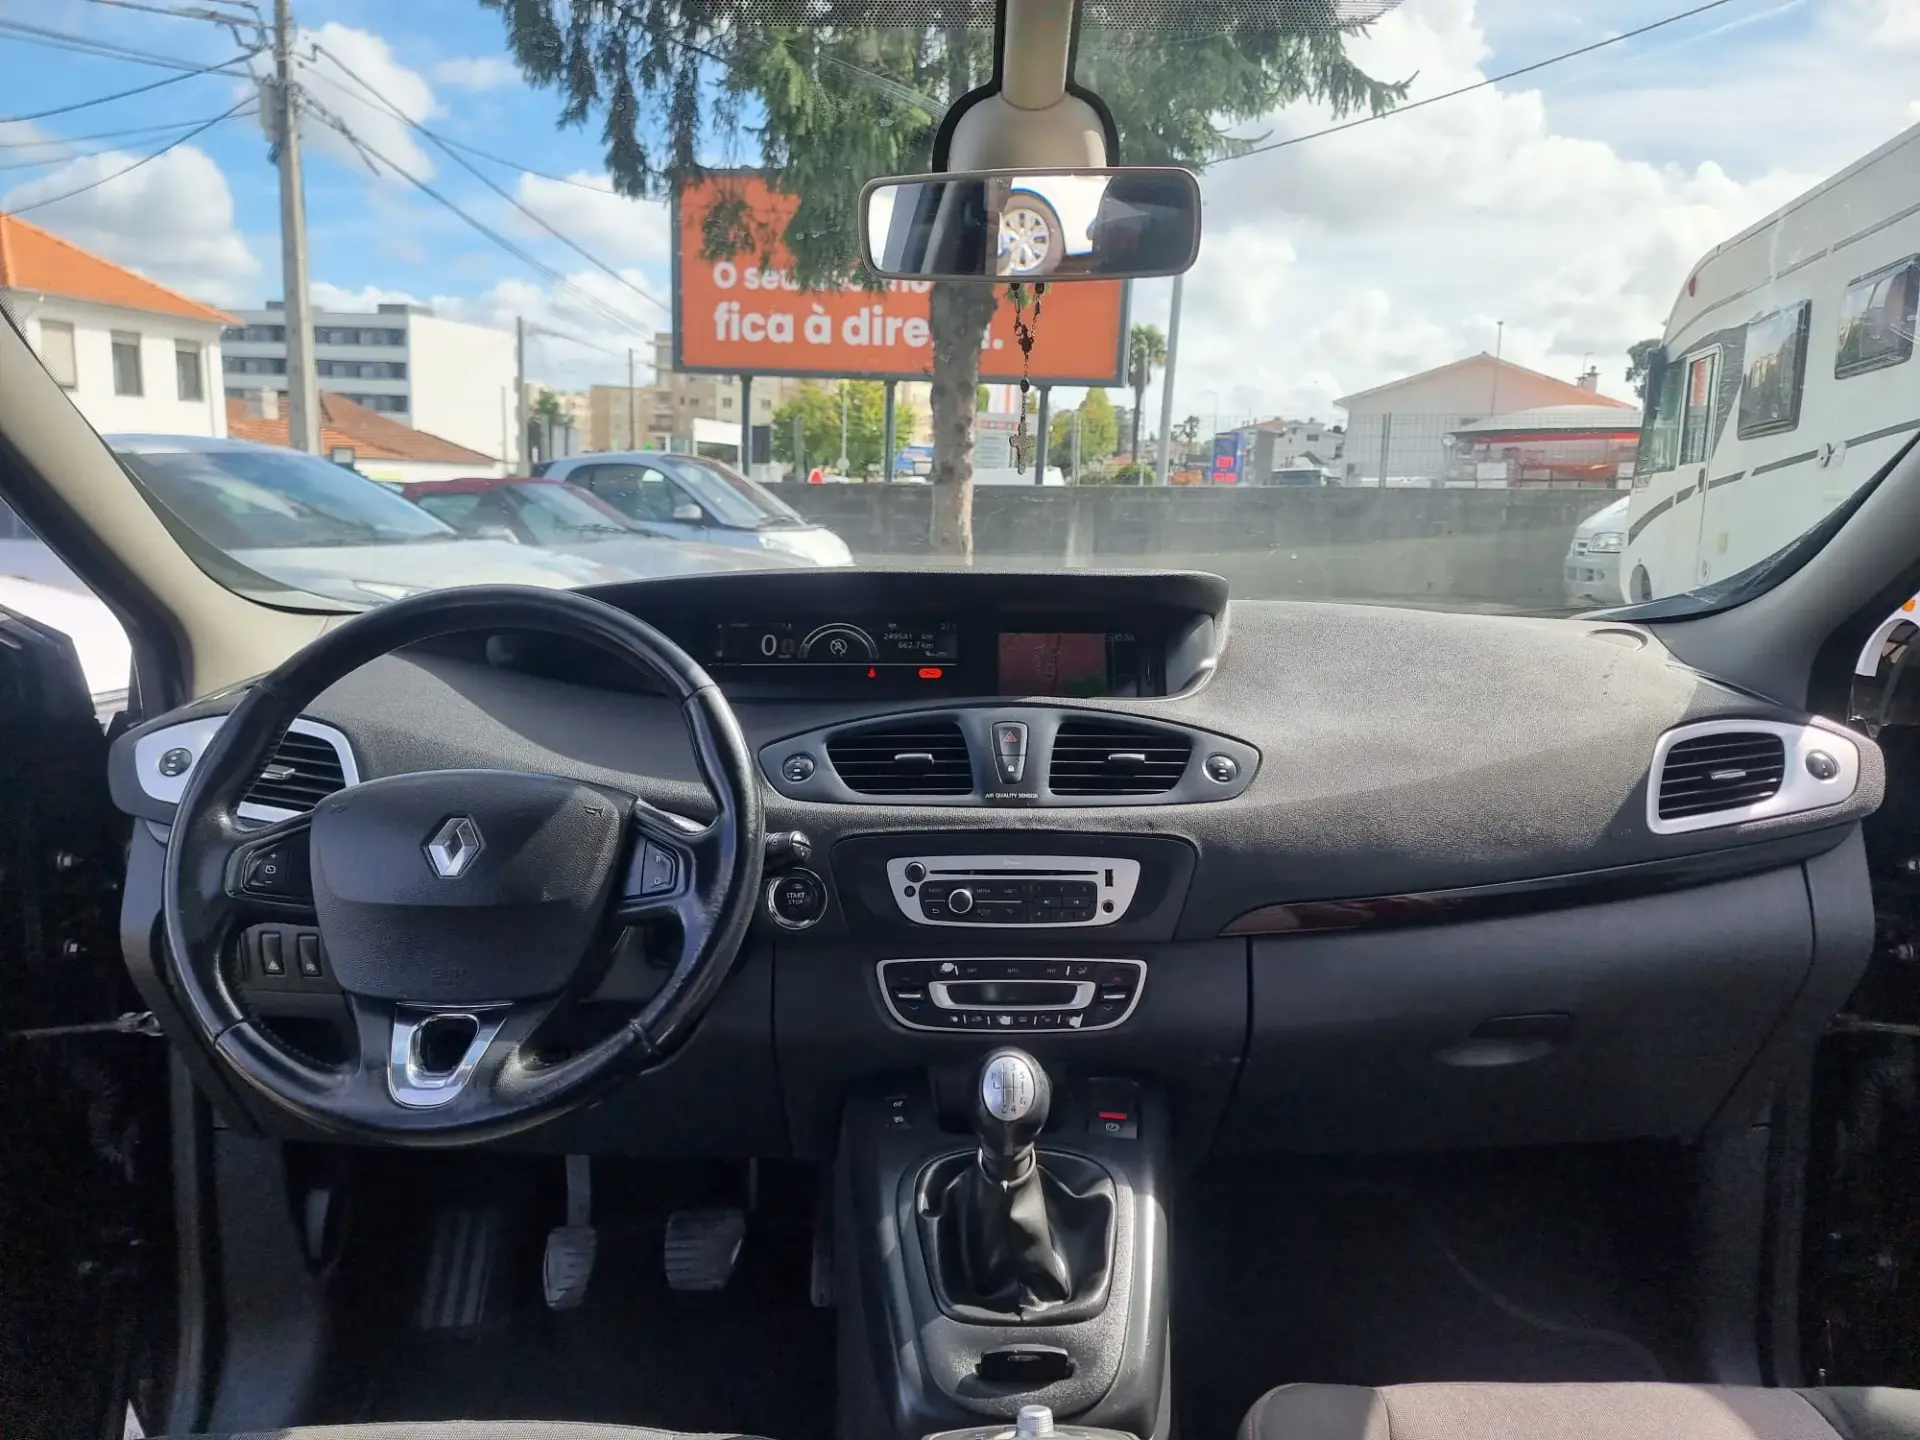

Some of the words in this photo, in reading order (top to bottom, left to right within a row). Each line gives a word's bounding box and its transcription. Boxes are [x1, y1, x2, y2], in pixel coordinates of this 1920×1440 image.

[713, 261, 738, 290] O
[714, 301, 795, 344] fica
[803, 302, 832, 345] à
[761, 633, 778, 656] 0
[655, 855, 662, 863] R
[1019, 1071, 1026, 1080] 5
[1010, 1104, 1017, 1115] 4
